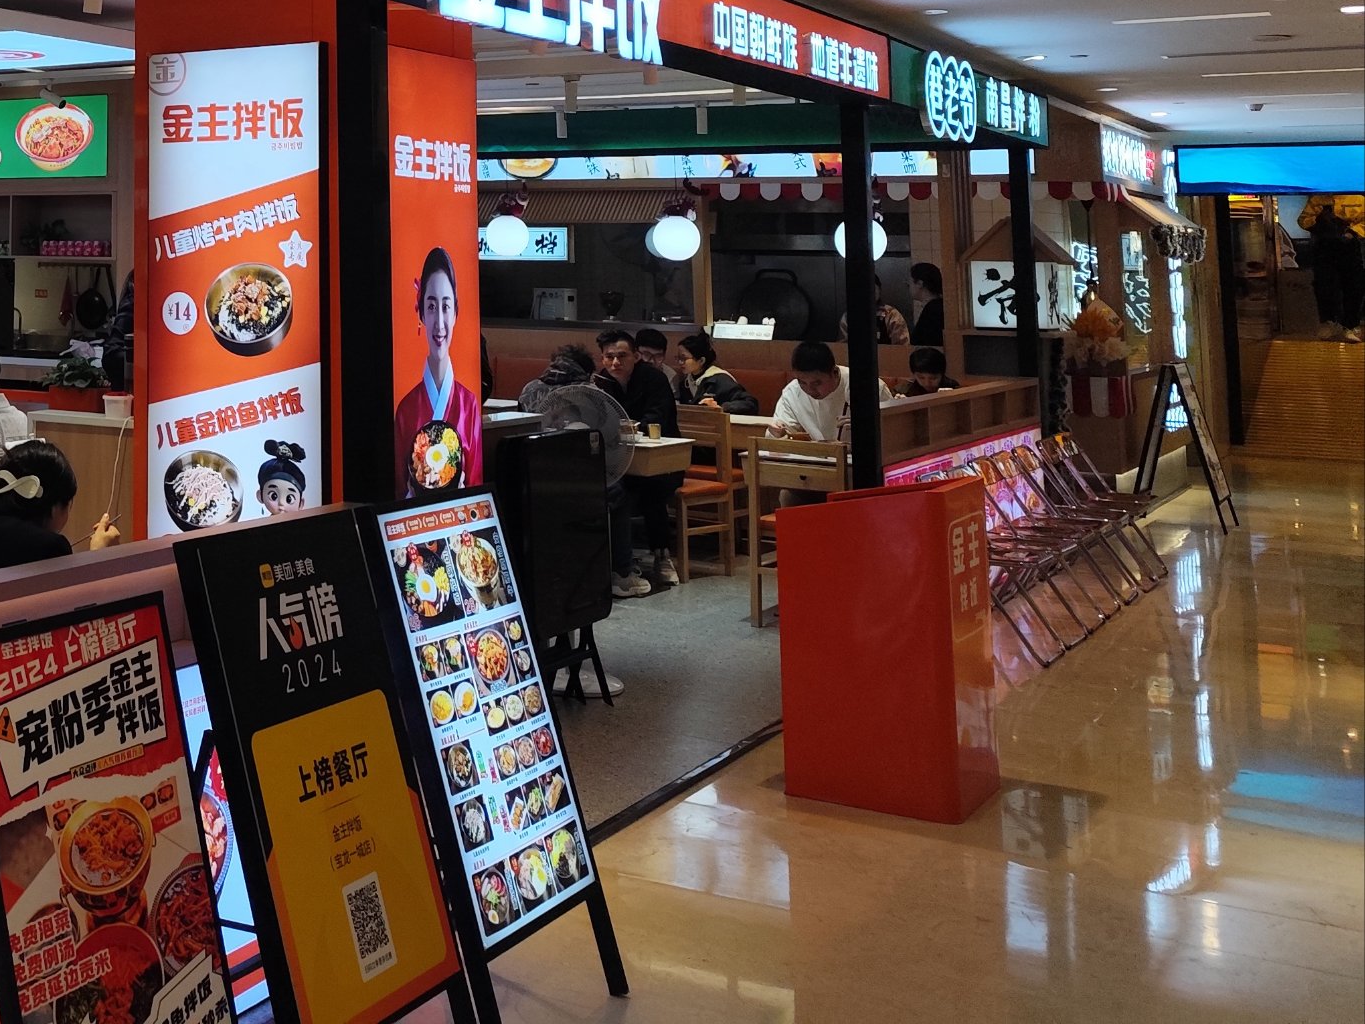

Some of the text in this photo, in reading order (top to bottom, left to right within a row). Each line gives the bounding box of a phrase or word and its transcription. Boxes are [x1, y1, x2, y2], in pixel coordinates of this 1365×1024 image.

[713, 1, 880, 93] 中国朝鲜族 地道非遗味
[162, 97, 304, 144] 金主拌饭
[928, 63, 975, 130] 巷老爷
[985, 76, 1041, 138] 南昌拌粉
[394, 134, 472, 183] 金主拌饭
[154, 193, 301, 263] 儿童烤牛肉拌饭
[167, 300, 192, 322] ¥14
[156, 386, 305, 450] 儿童金枪鱼拌饭
[952, 521, 980, 576] 金主
[0, 631, 54, 661] 金主拌饭
[62, 613, 137, 673] 上榜餐厅
[258, 581, 345, 661] 人气榜
[109, 649, 157, 702] 金主
[282, 649, 343, 694] 2024
[15, 675, 116, 773] 宠粉季
[115, 688, 165, 745] 拌饭
[298, 741, 370, 803] 上榜餐厅
